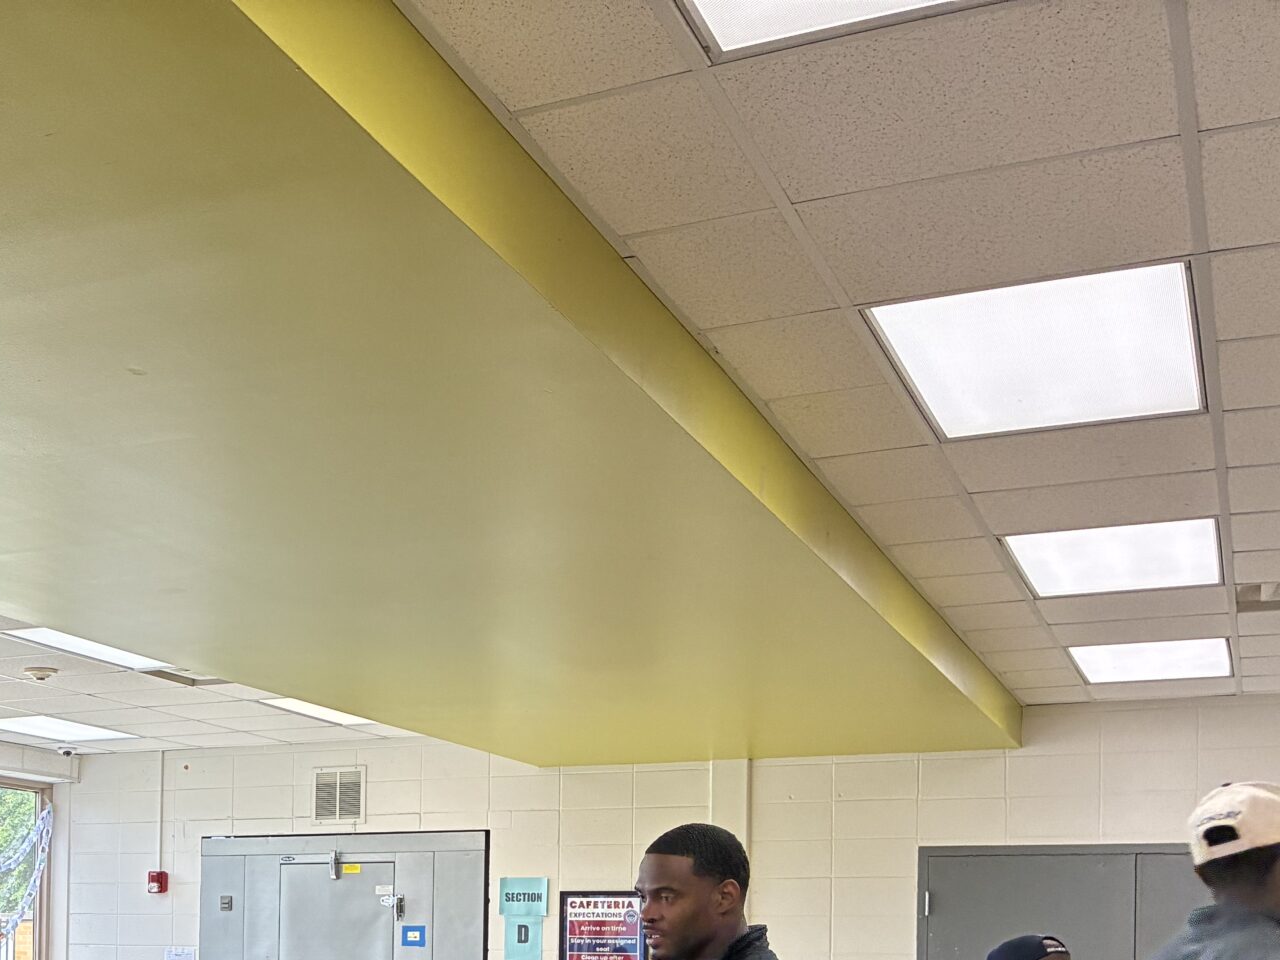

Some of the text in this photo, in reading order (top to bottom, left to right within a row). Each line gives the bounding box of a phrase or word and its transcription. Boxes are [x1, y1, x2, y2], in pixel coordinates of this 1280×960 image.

[505, 892, 542, 902] SECTION
[569, 900, 634, 909] CAFETERIA
[517, 924, 529, 944] D
